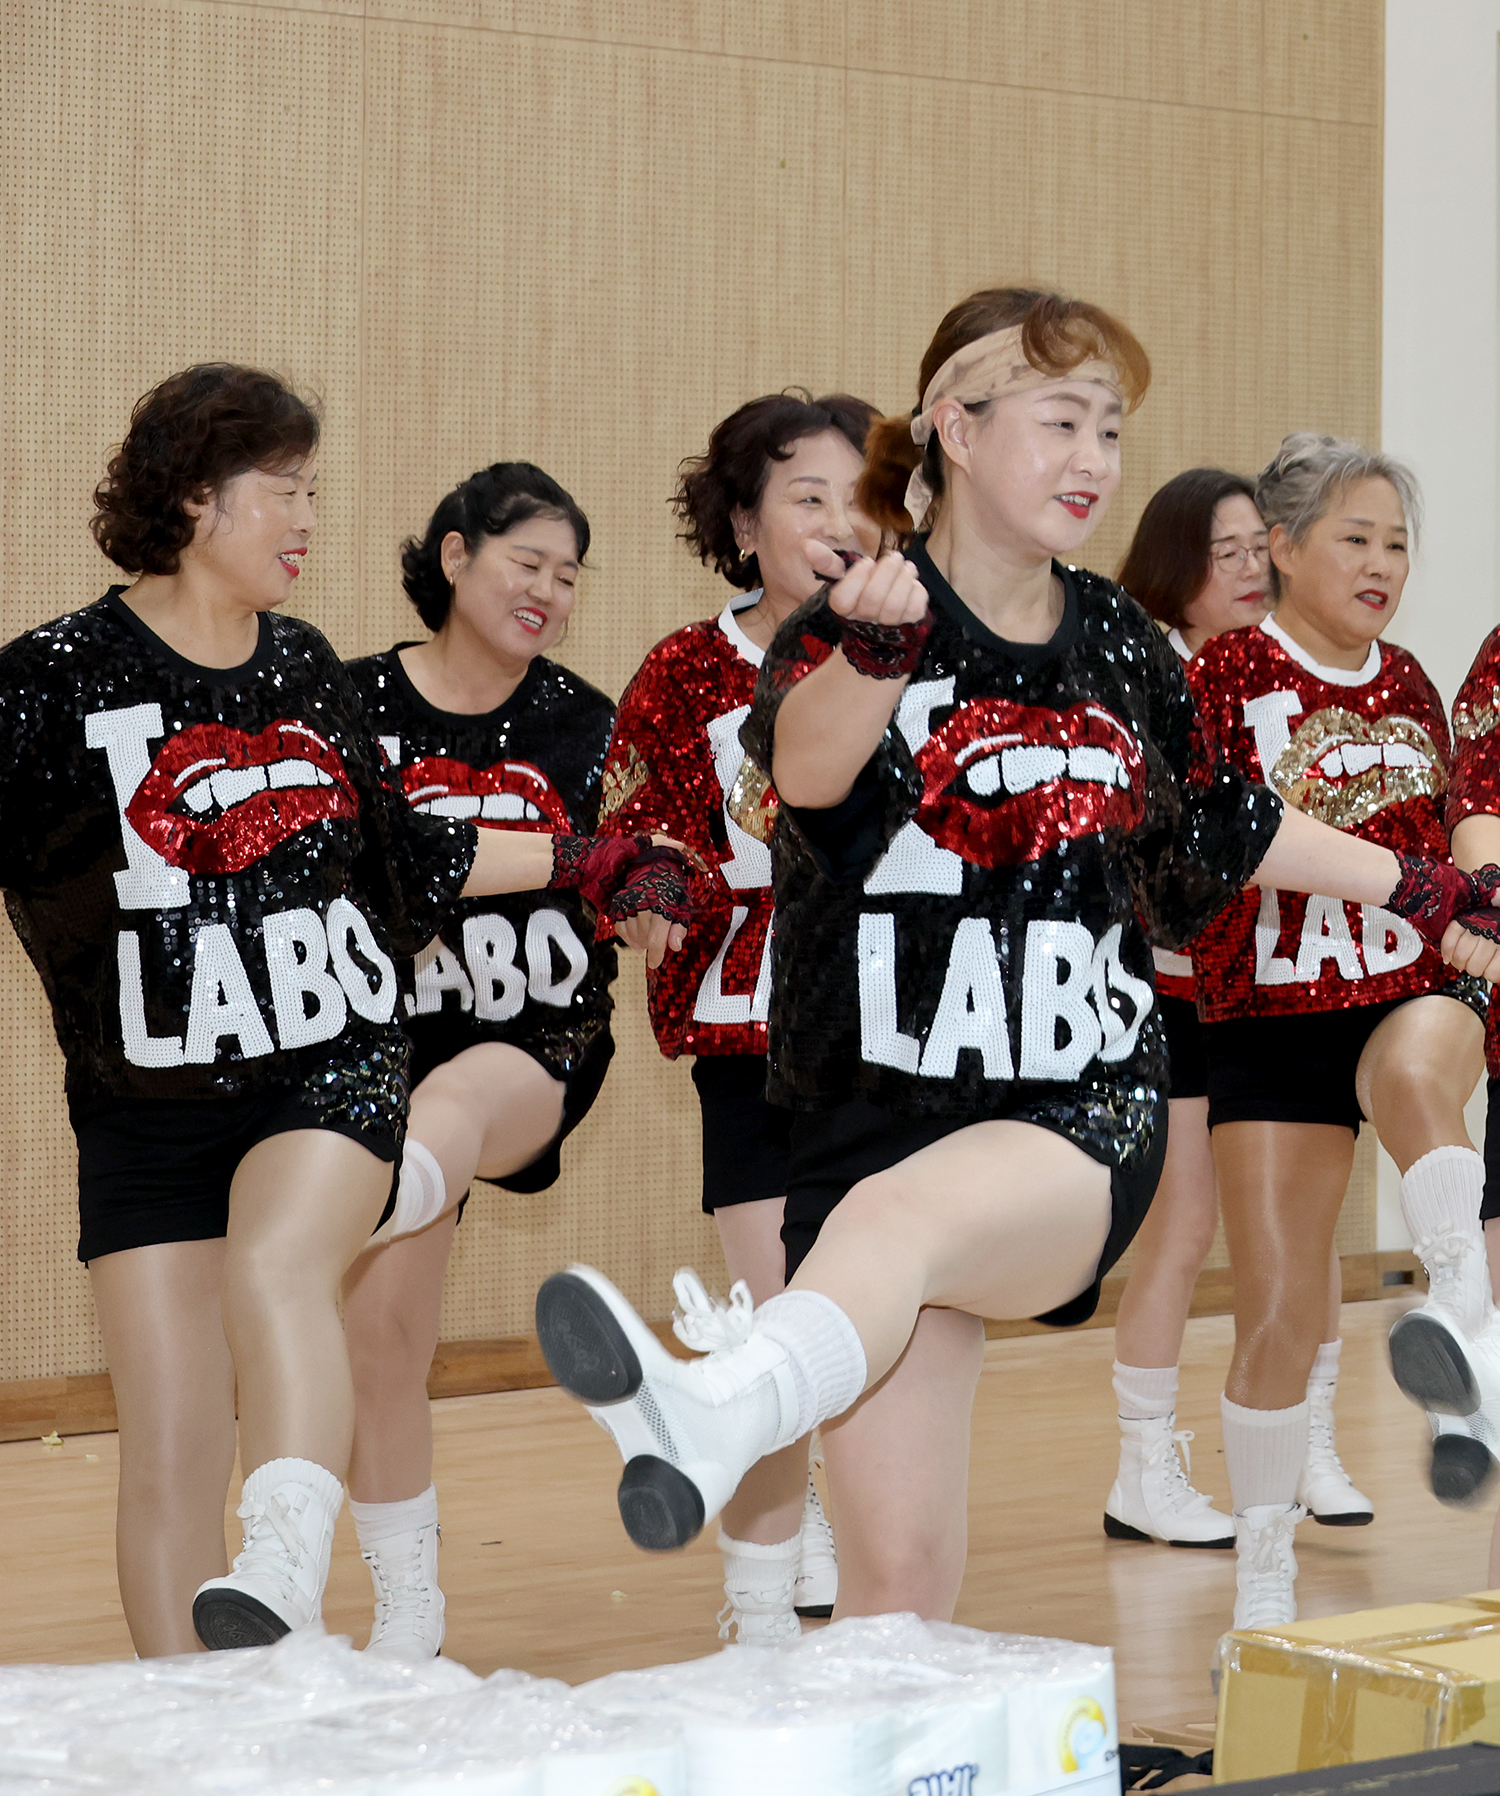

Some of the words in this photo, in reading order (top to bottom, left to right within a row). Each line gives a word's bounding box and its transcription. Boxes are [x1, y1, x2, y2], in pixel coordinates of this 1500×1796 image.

[85, 702, 192, 910] I
[117, 898, 398, 1068] LABO
[403, 908, 589, 1022] ABO
